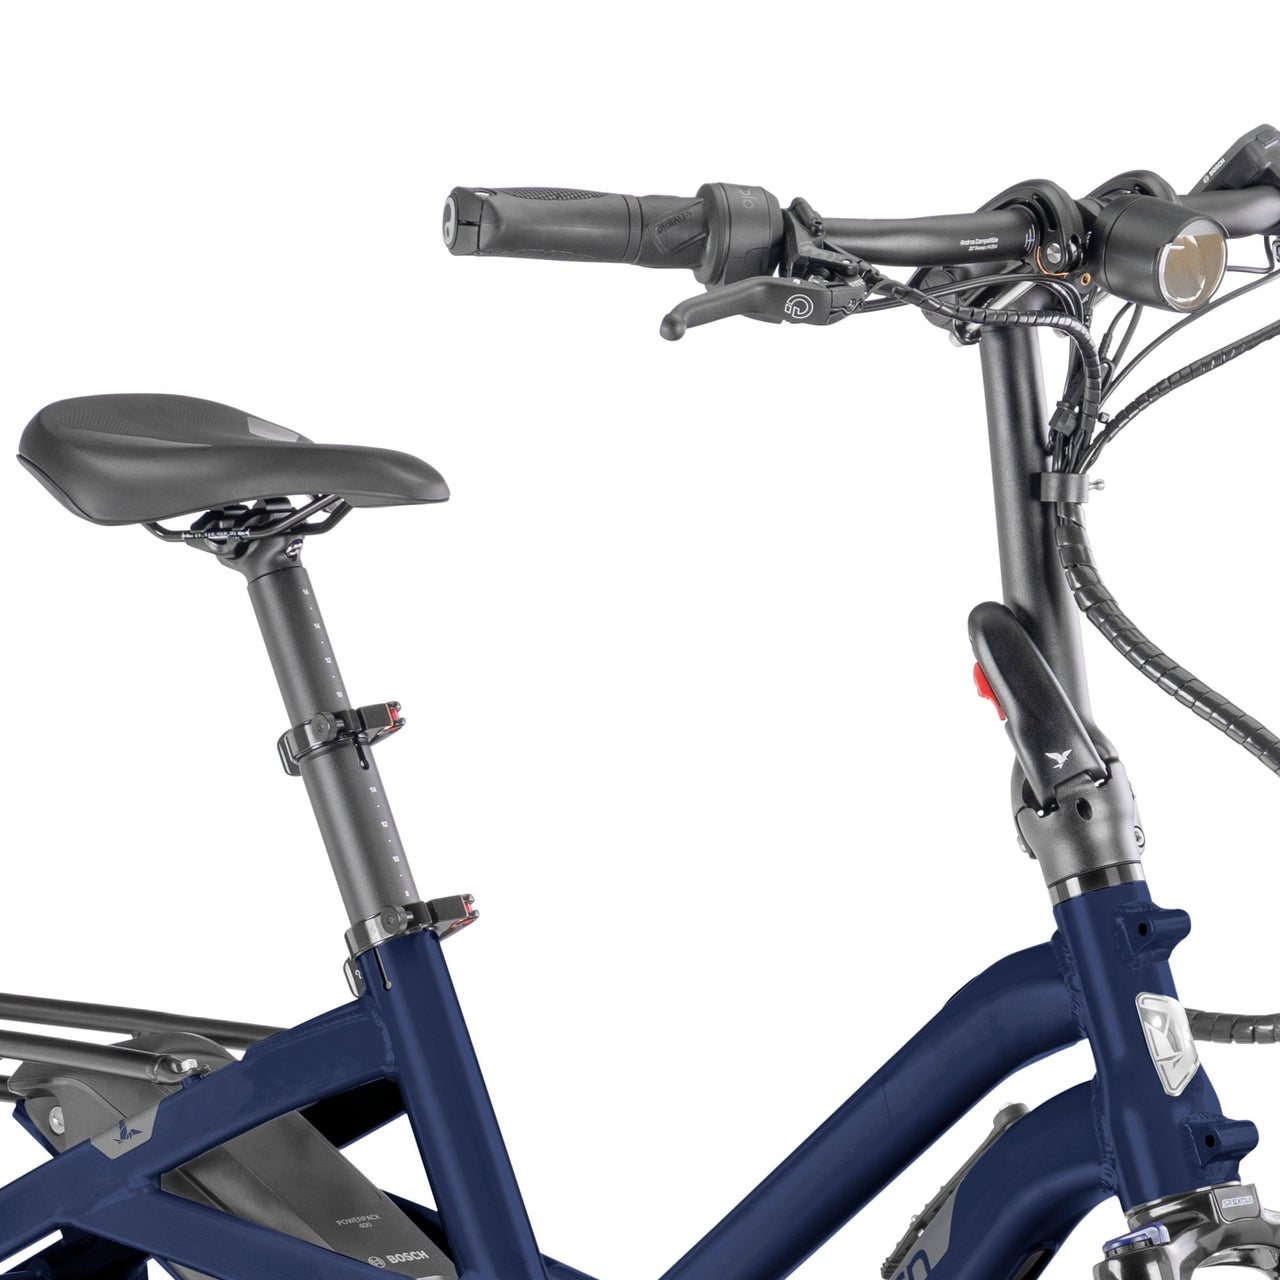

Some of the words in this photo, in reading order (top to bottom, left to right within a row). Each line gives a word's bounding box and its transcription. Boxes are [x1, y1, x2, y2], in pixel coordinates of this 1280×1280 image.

[1209, 157, 1226, 177] BOSCH
[336, 1214, 382, 1226] POWERPACK
[386, 1250, 430, 1264] BOSCH
